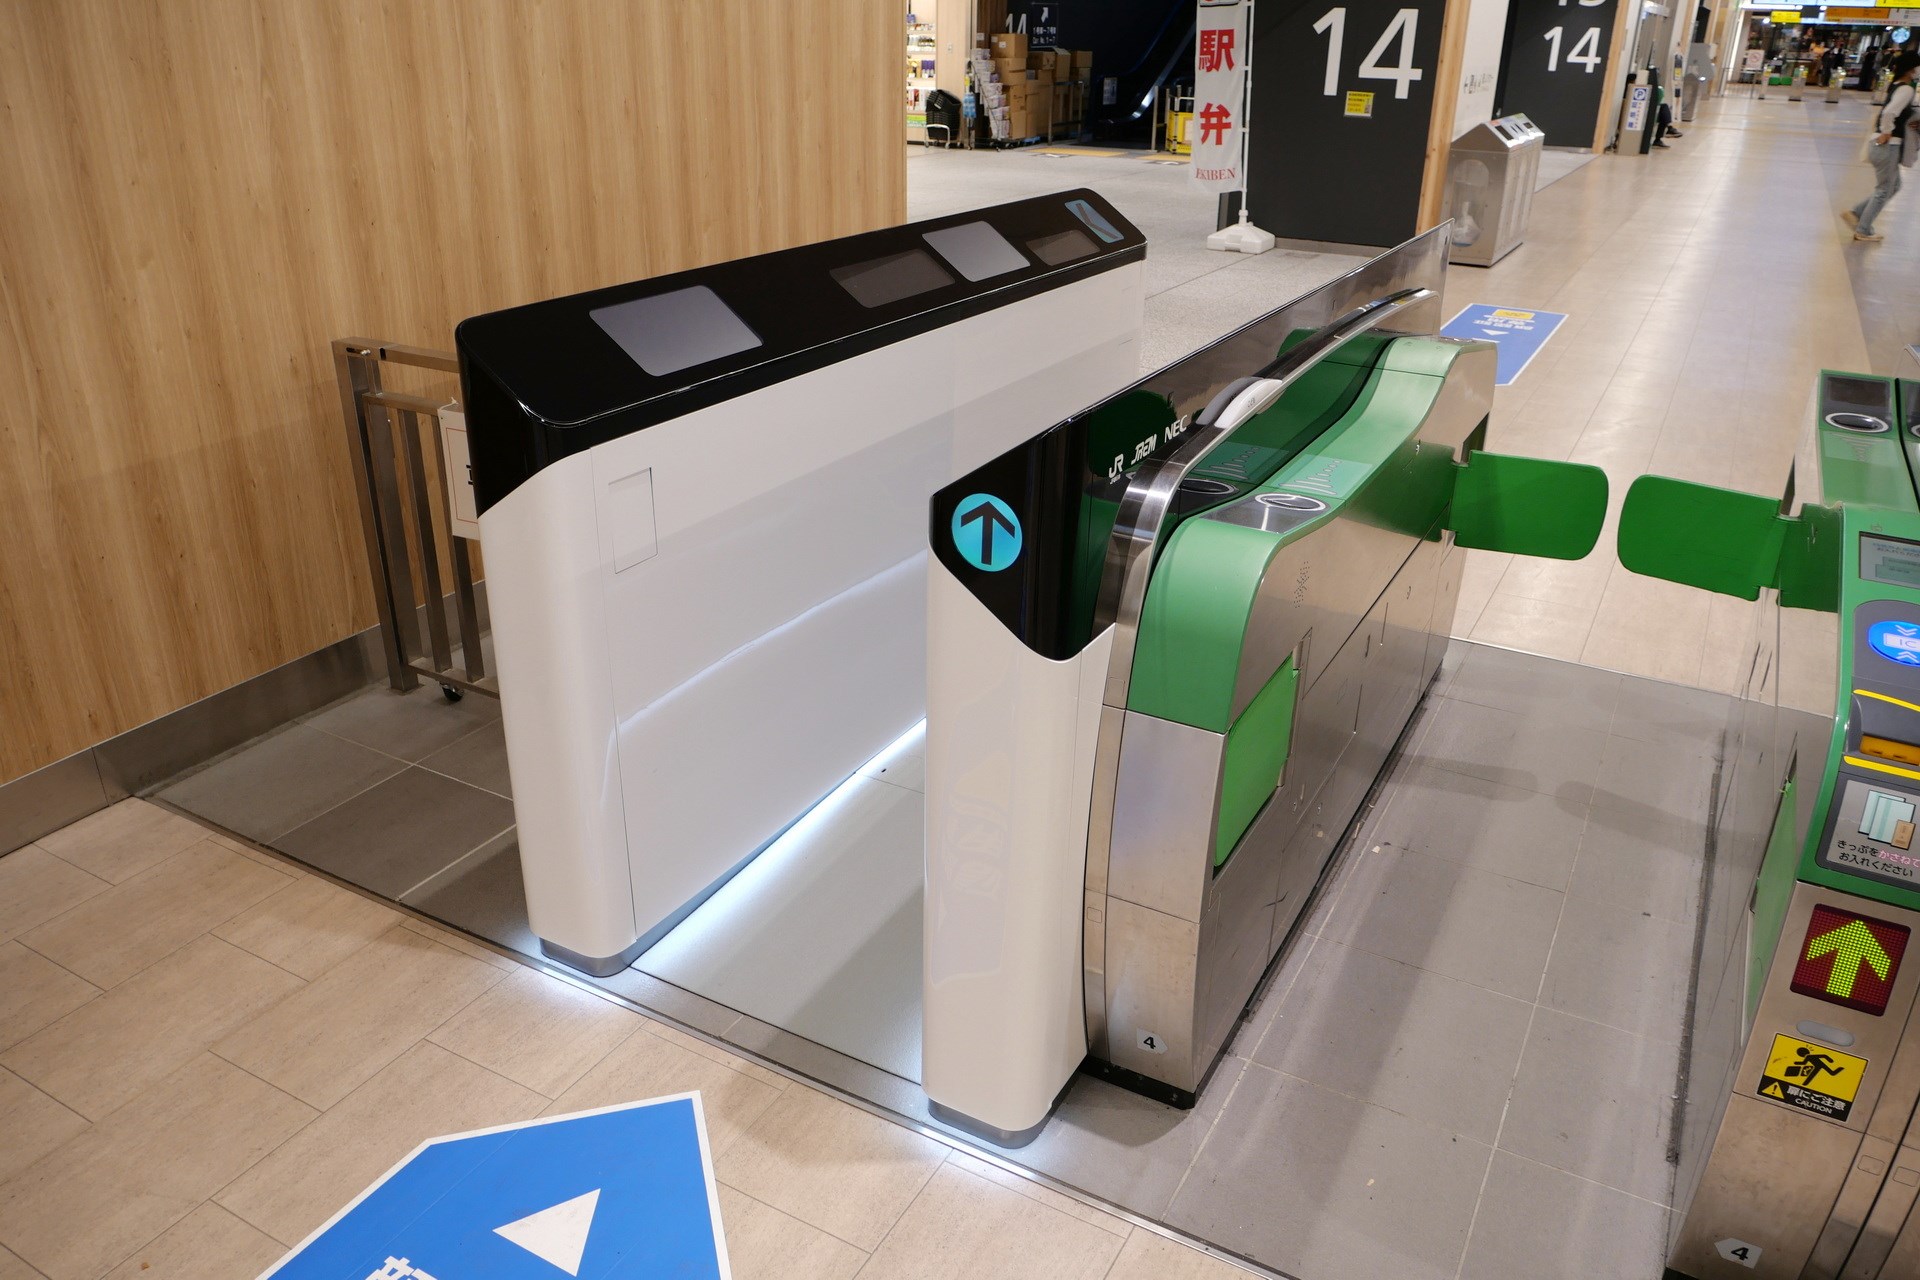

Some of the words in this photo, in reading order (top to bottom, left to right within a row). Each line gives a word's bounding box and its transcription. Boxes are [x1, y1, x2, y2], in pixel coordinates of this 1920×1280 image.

[1313, 7, 1422, 99] 14
[1543, 26, 1602, 73] 14
[1199, 29, 1235, 146] 駅弁
[1195, 168, 1236, 181] EKIBEN
[1109, 453, 1124, 478] JR
[1164, 414, 1188, 443] NEC
[1837, 840, 1920, 868] きっぷをかさねて
[1839, 852, 1913, 877] お入れください
[1143, 1036, 1156, 1049] 4
[1795, 1098, 1833, 1114] CAUTION
[1730, 1246, 1749, 1261] 4
